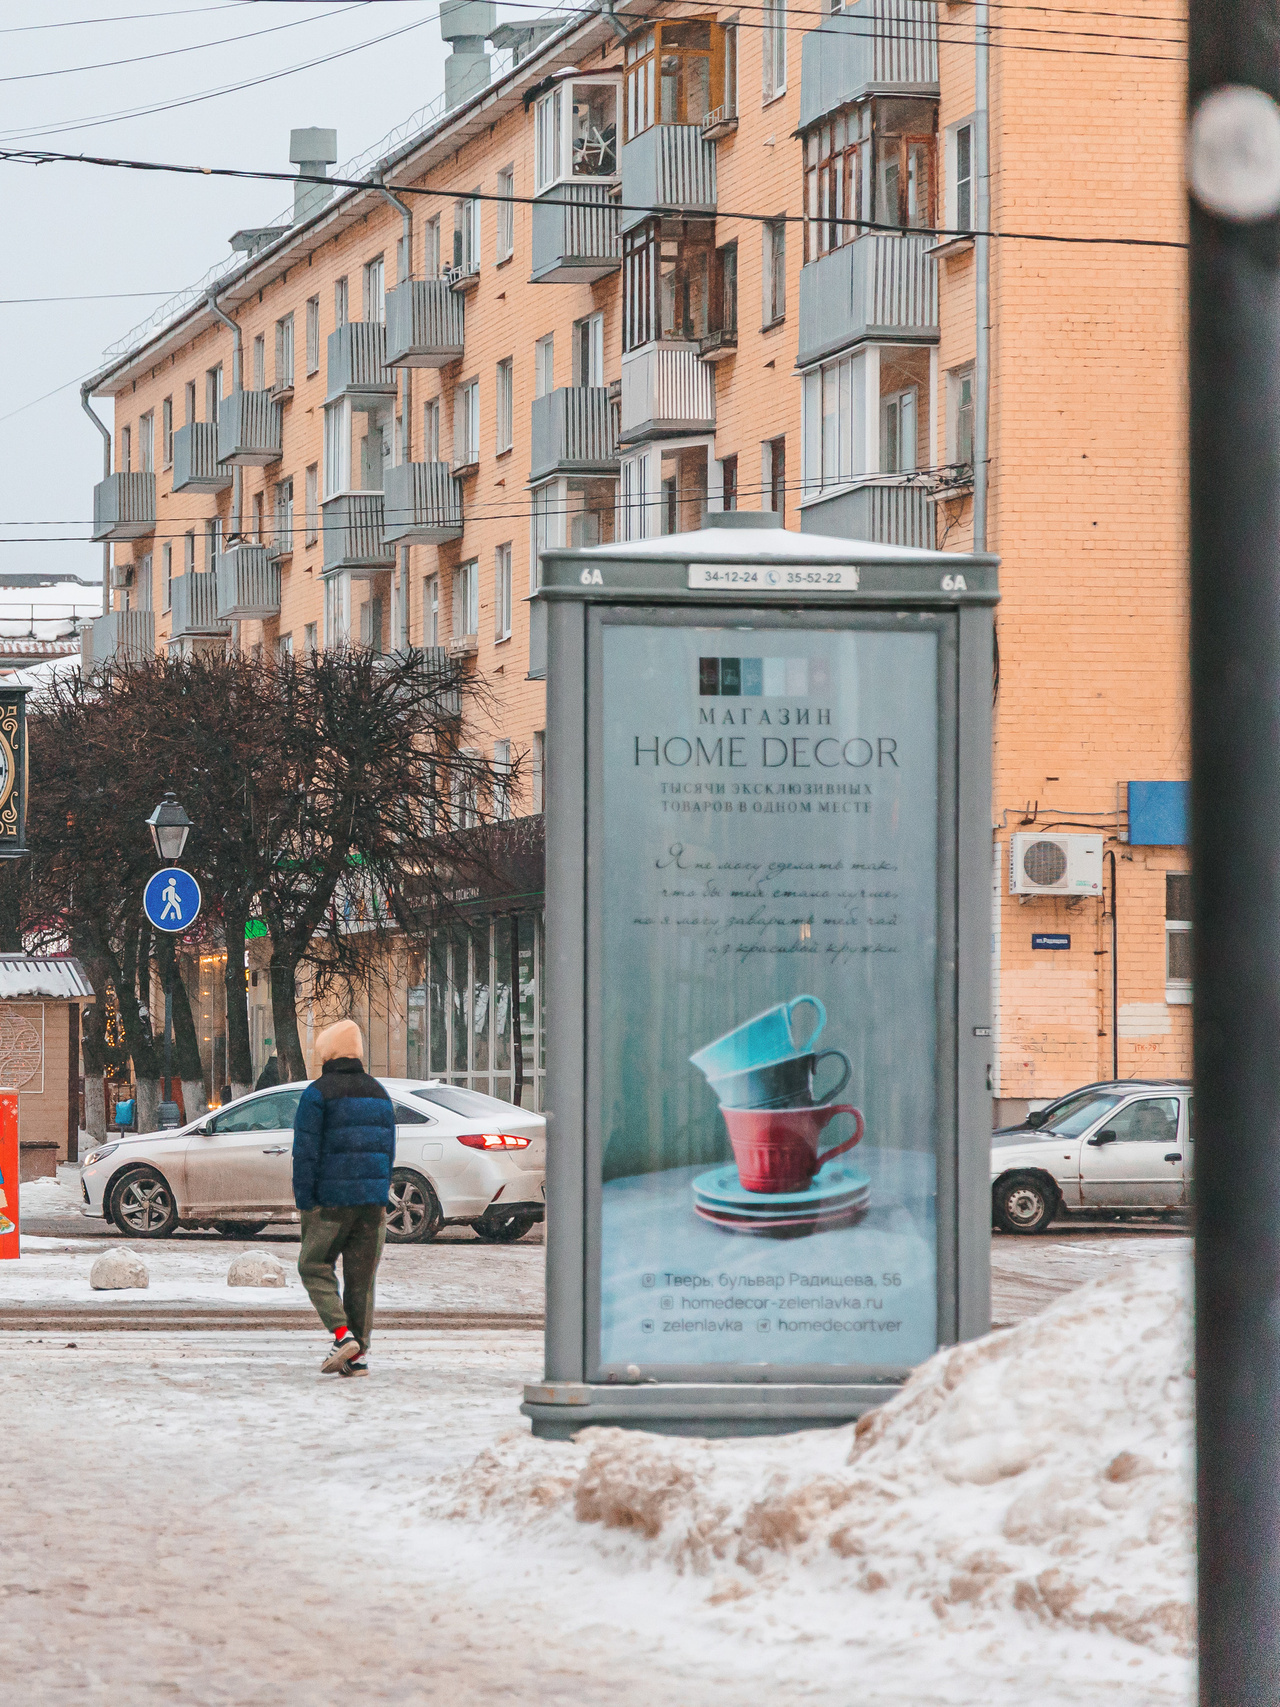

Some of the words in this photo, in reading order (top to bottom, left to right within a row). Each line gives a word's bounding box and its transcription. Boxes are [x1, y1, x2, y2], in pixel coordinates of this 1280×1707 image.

[581, 568, 603, 585] 6А
[704, 570, 758, 583] 34-12-24
[787, 571, 842, 584] 35-52-22
[941, 574, 967, 591] 6А
[698, 707, 832, 726] МАГАЗИН
[634, 735, 747, 767] HOME
[762, 736, 900, 768] DECOR
[661, 782, 725, 795] ТЫСЯЧИ
[731, 782, 873, 796] ЭКСКЛЮЗИВНЫХ
[662, 801, 733, 814] ТОВАРОВ
[739, 801, 748, 813] В
[753, 801, 813, 815] ОДНОМ
[819, 802, 873, 814] МЕСТЕ
[655, 842, 691, 870] Я
[694, 862, 712, 870] не
[718, 861, 762, 881] могу
[758, 860, 844, 882] сделать
[720, 1272, 784, 1291] бульвар
[789, 1273, 877, 1289] Радищева,
[882, 1273, 902, 1287] 56
[662, 1317, 743, 1333] zelenlavka
[778, 1317, 902, 1333] homedecortver
